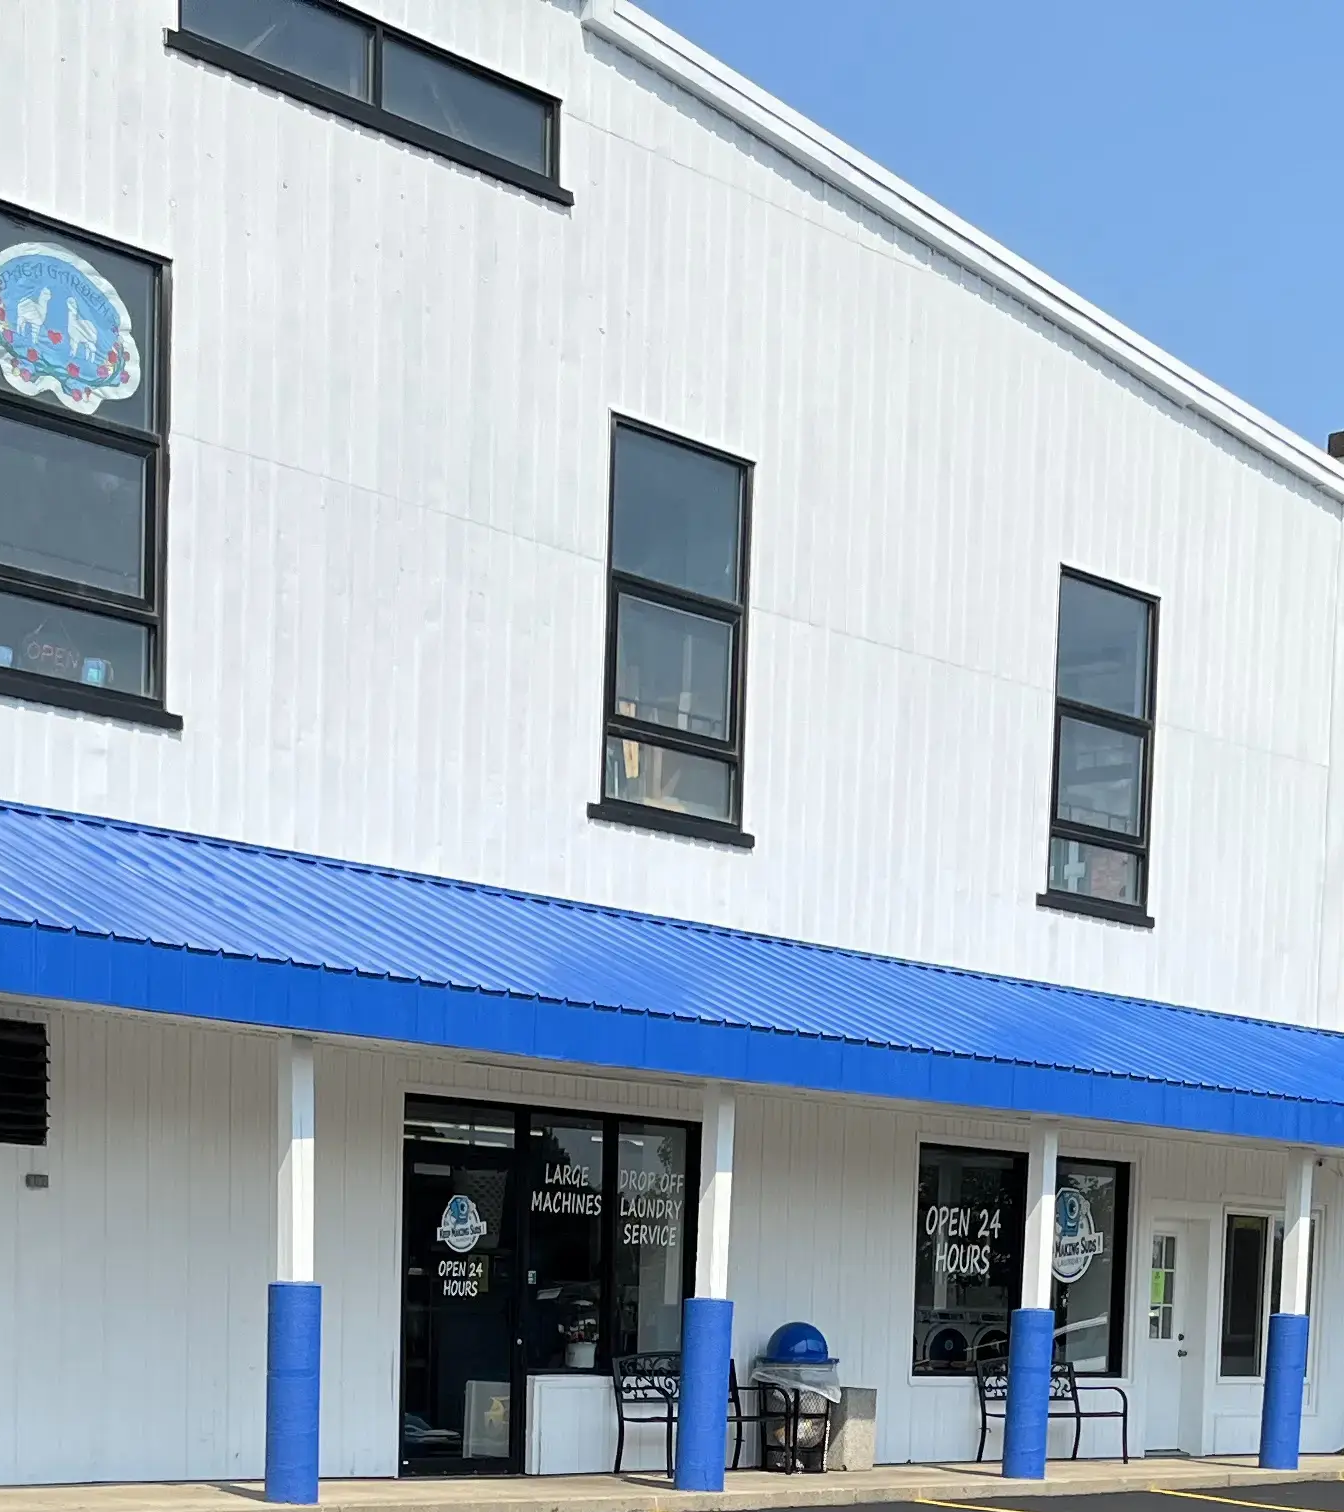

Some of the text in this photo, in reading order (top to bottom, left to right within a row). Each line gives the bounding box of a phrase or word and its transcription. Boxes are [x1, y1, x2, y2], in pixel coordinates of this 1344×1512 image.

[545, 1163, 589, 1187] LARGE
[619, 1169, 684, 1193] DROP OFF
[531, 1191, 602, 1216] MACHINES
[619, 1197, 682, 1220] LAUNDRY
[925, 1205, 1002, 1240] OPEN 24
[623, 1223, 677, 1247] SERVICE
[438, 1260, 484, 1278] OPEN 24
[935, 1241, 990, 1276] HOURS
[443, 1279, 478, 1297] HOURS
